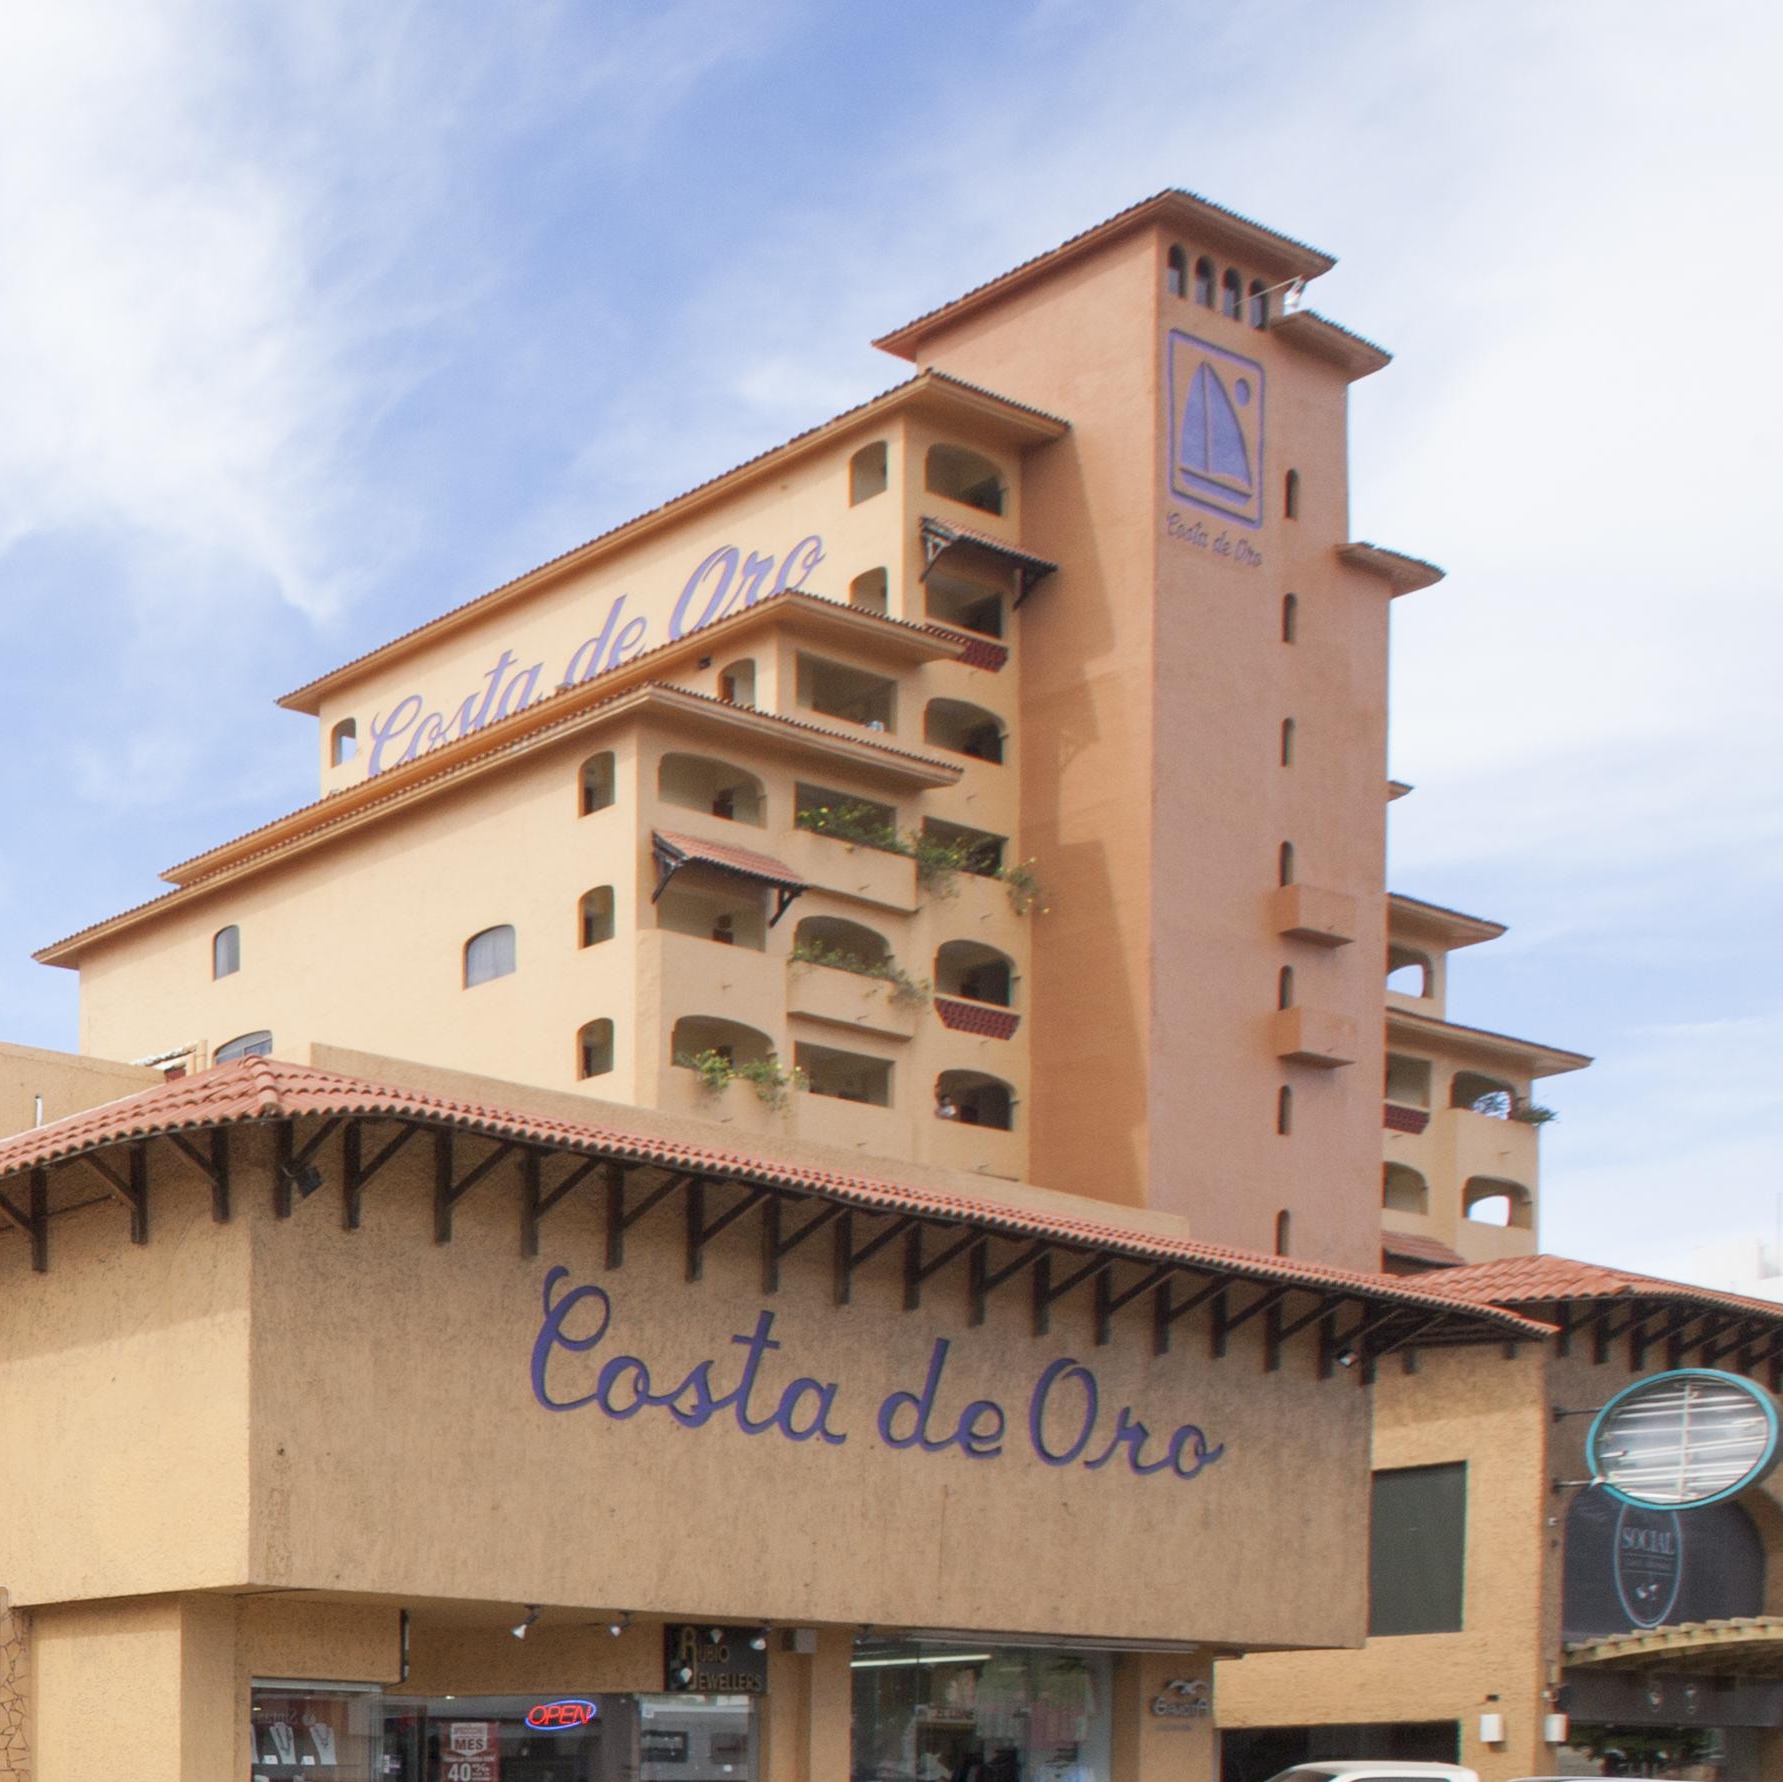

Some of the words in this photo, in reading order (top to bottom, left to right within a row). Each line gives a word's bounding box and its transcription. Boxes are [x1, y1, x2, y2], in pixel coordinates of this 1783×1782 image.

[368, 648, 543, 778] Costa
[563, 594, 648, 687] de
[668, 534, 827, 642] Oro
[530, 1265, 846, 1445] Costa
[878, 1338, 1005, 1459] de
[1029, 1357, 1225, 1479] Oro
[1622, 1526, 1676, 1555] SOCIAL
[687, 1661, 762, 1692] JEWELLERS
[528, 1704, 592, 1726] OPEN
[454, 1738, 484, 1751] MES
